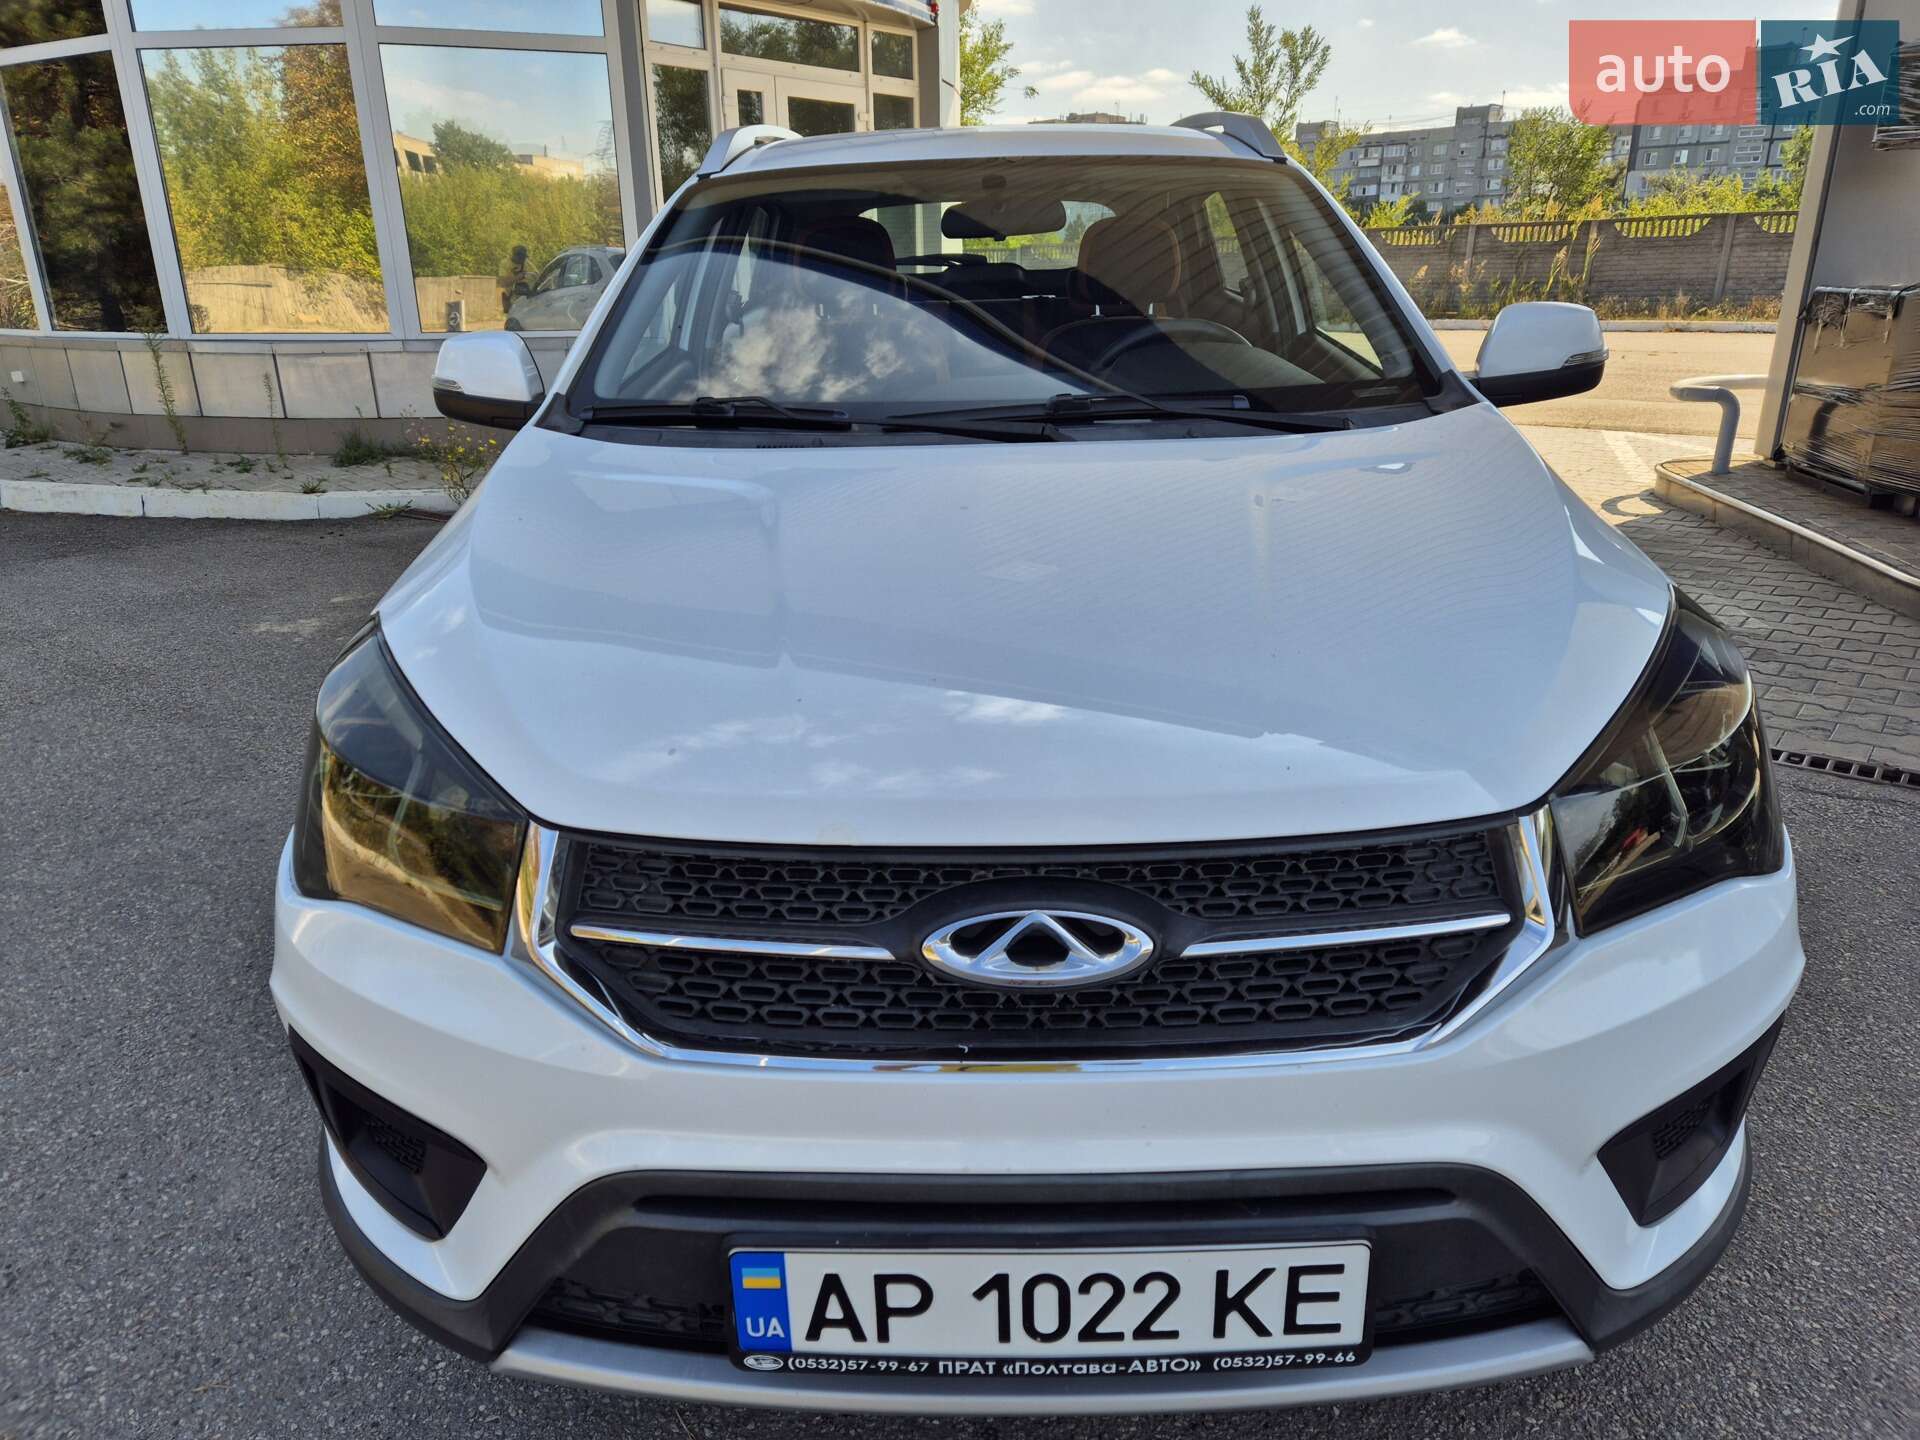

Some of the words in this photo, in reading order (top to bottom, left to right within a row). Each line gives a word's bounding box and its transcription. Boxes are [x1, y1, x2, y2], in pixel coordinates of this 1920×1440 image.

[804, 1272, 934, 1343] AP
[972, 1271, 1182, 1344] 1022
[1212, 1263, 1346, 1338] KE
[746, 1316, 785, 1339] UA
[788, 1357, 930, 1373] (0532)57-99-67
[938, 1361, 996, 1375] ПРАТ
[1002, 1358, 1201, 1376] «Полтава-АВТО»
[1212, 1351, 1357, 1371] (0532)57-99-66
